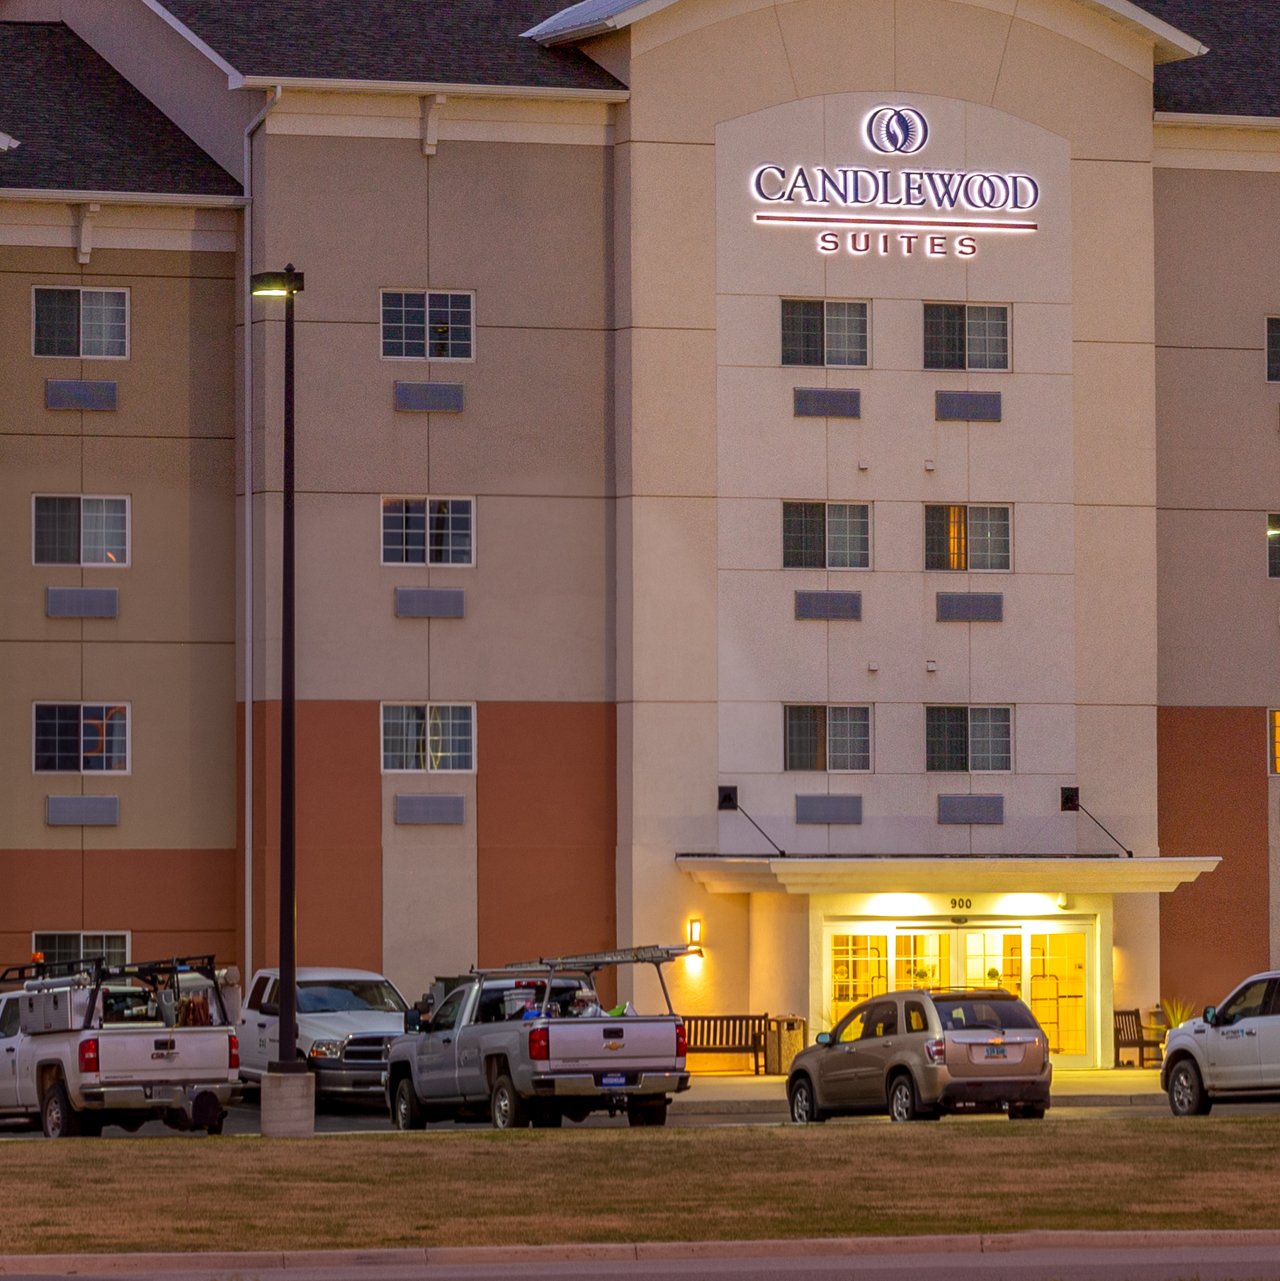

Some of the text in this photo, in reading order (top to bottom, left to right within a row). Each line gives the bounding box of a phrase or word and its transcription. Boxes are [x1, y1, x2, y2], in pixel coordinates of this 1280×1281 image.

[754, 166, 1039, 210] CANDLEWOOD
[819, 232, 977, 256] SUITES
[950, 898, 972, 909] 900
